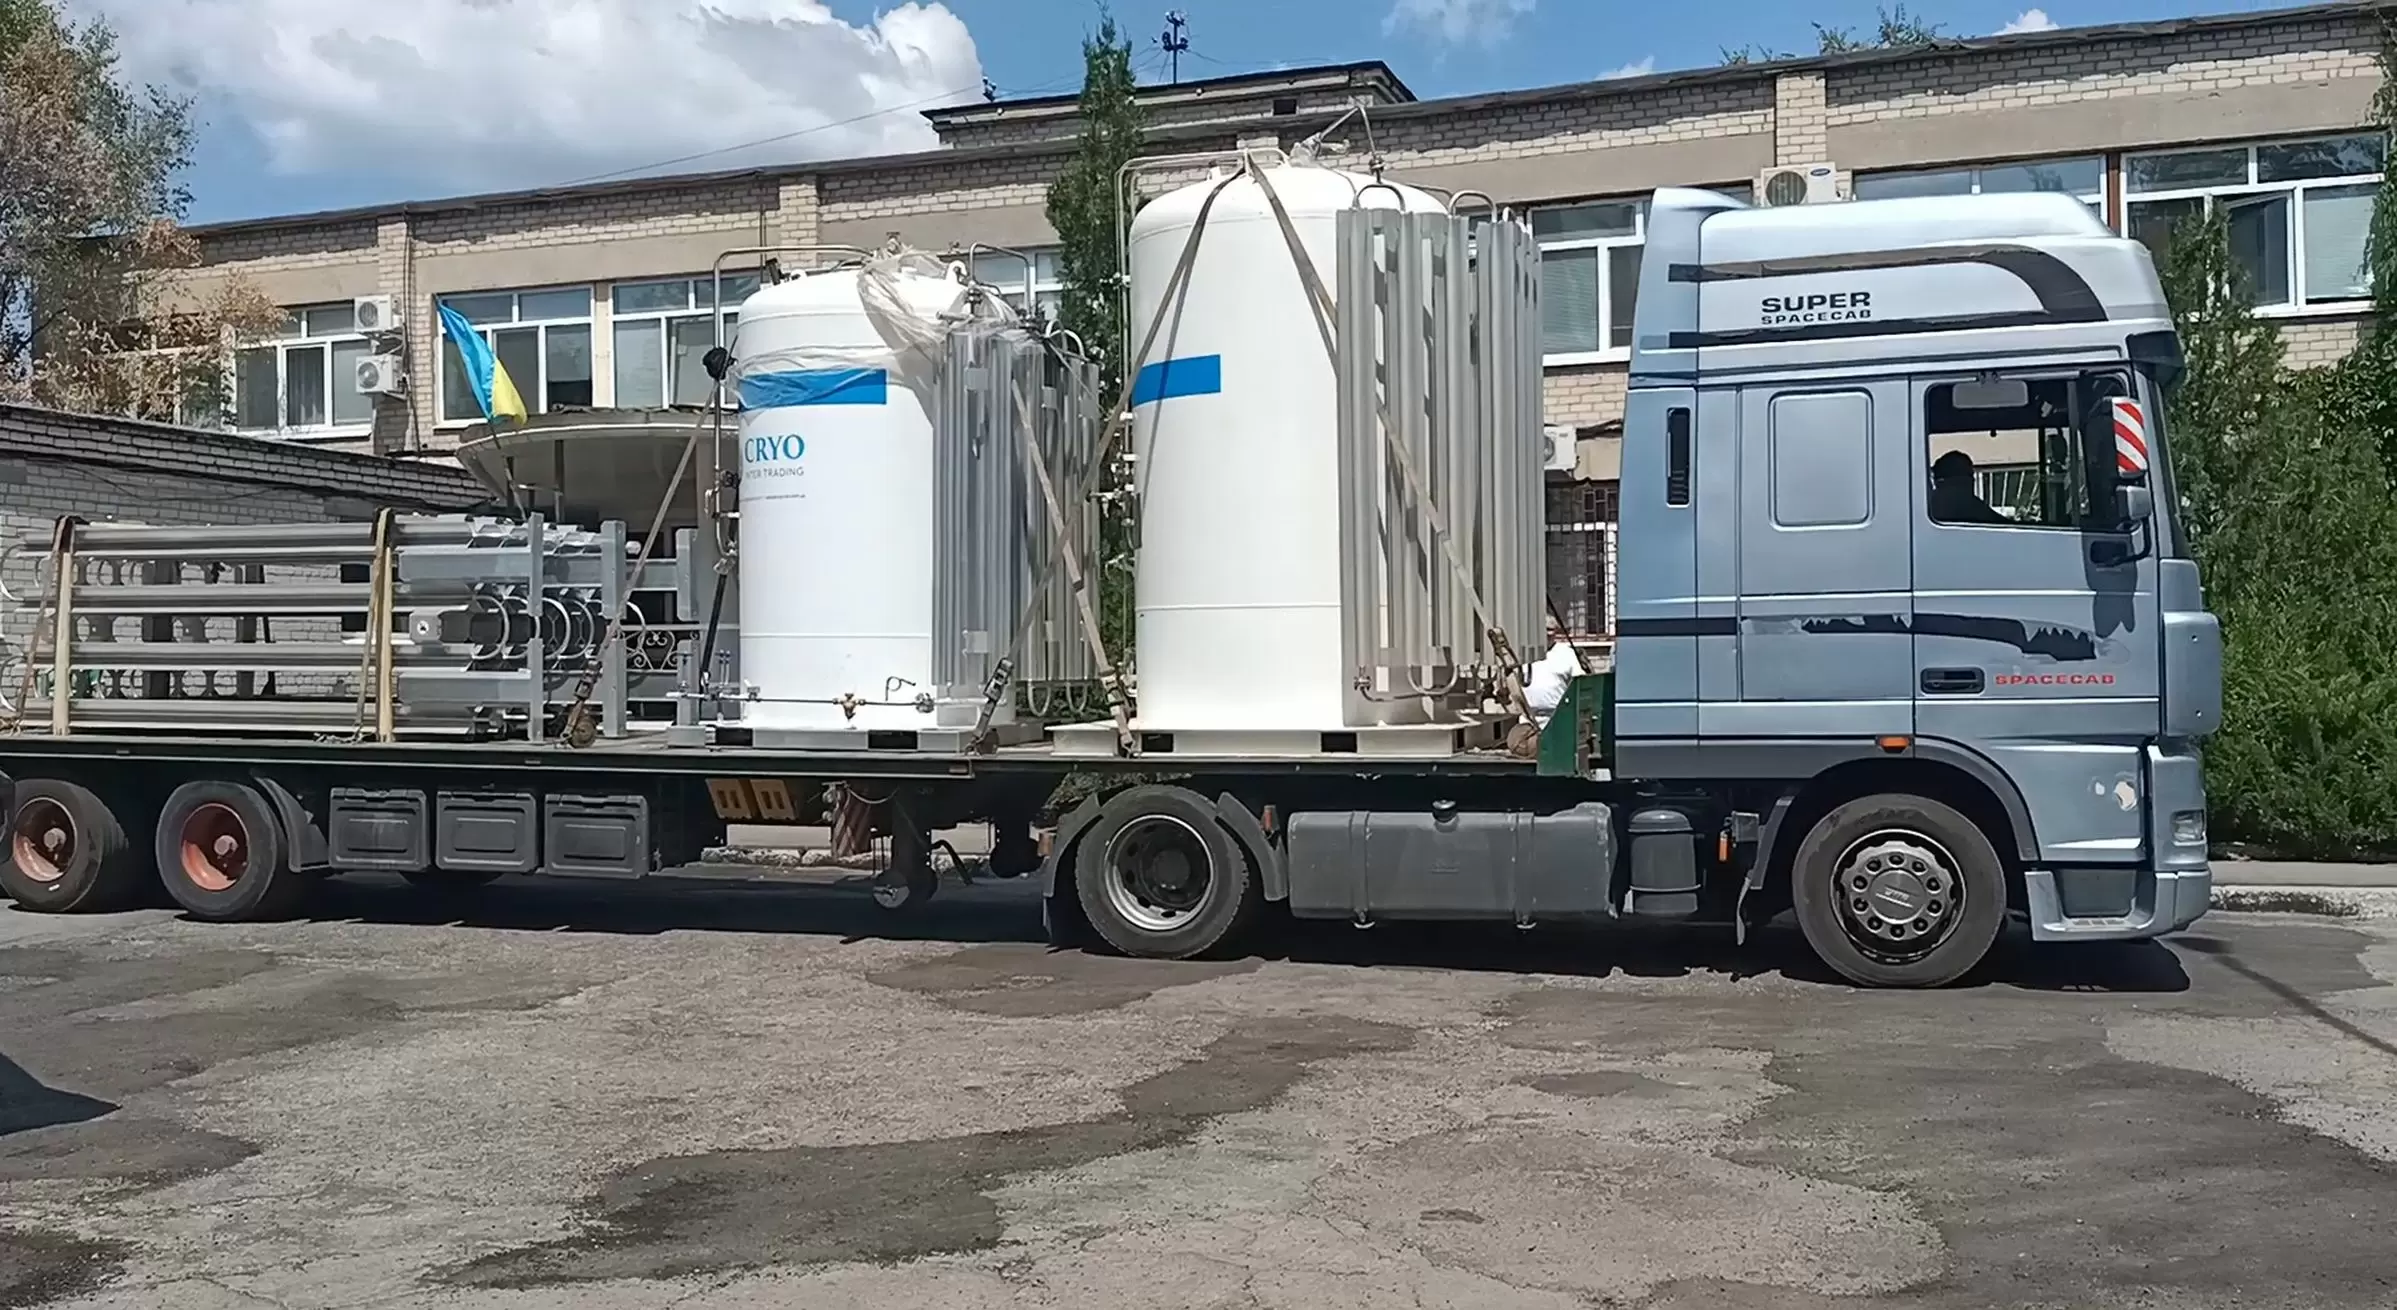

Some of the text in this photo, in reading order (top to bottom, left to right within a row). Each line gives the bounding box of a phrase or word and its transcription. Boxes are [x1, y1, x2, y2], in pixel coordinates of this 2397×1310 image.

[1761, 292, 1871, 313] SUPER
[1761, 309, 1872, 325] SPACECAB
[744, 434, 805, 463] CRYO
[763, 466, 804, 478] TRADING
[1995, 674, 2114, 685] SPACECAB
